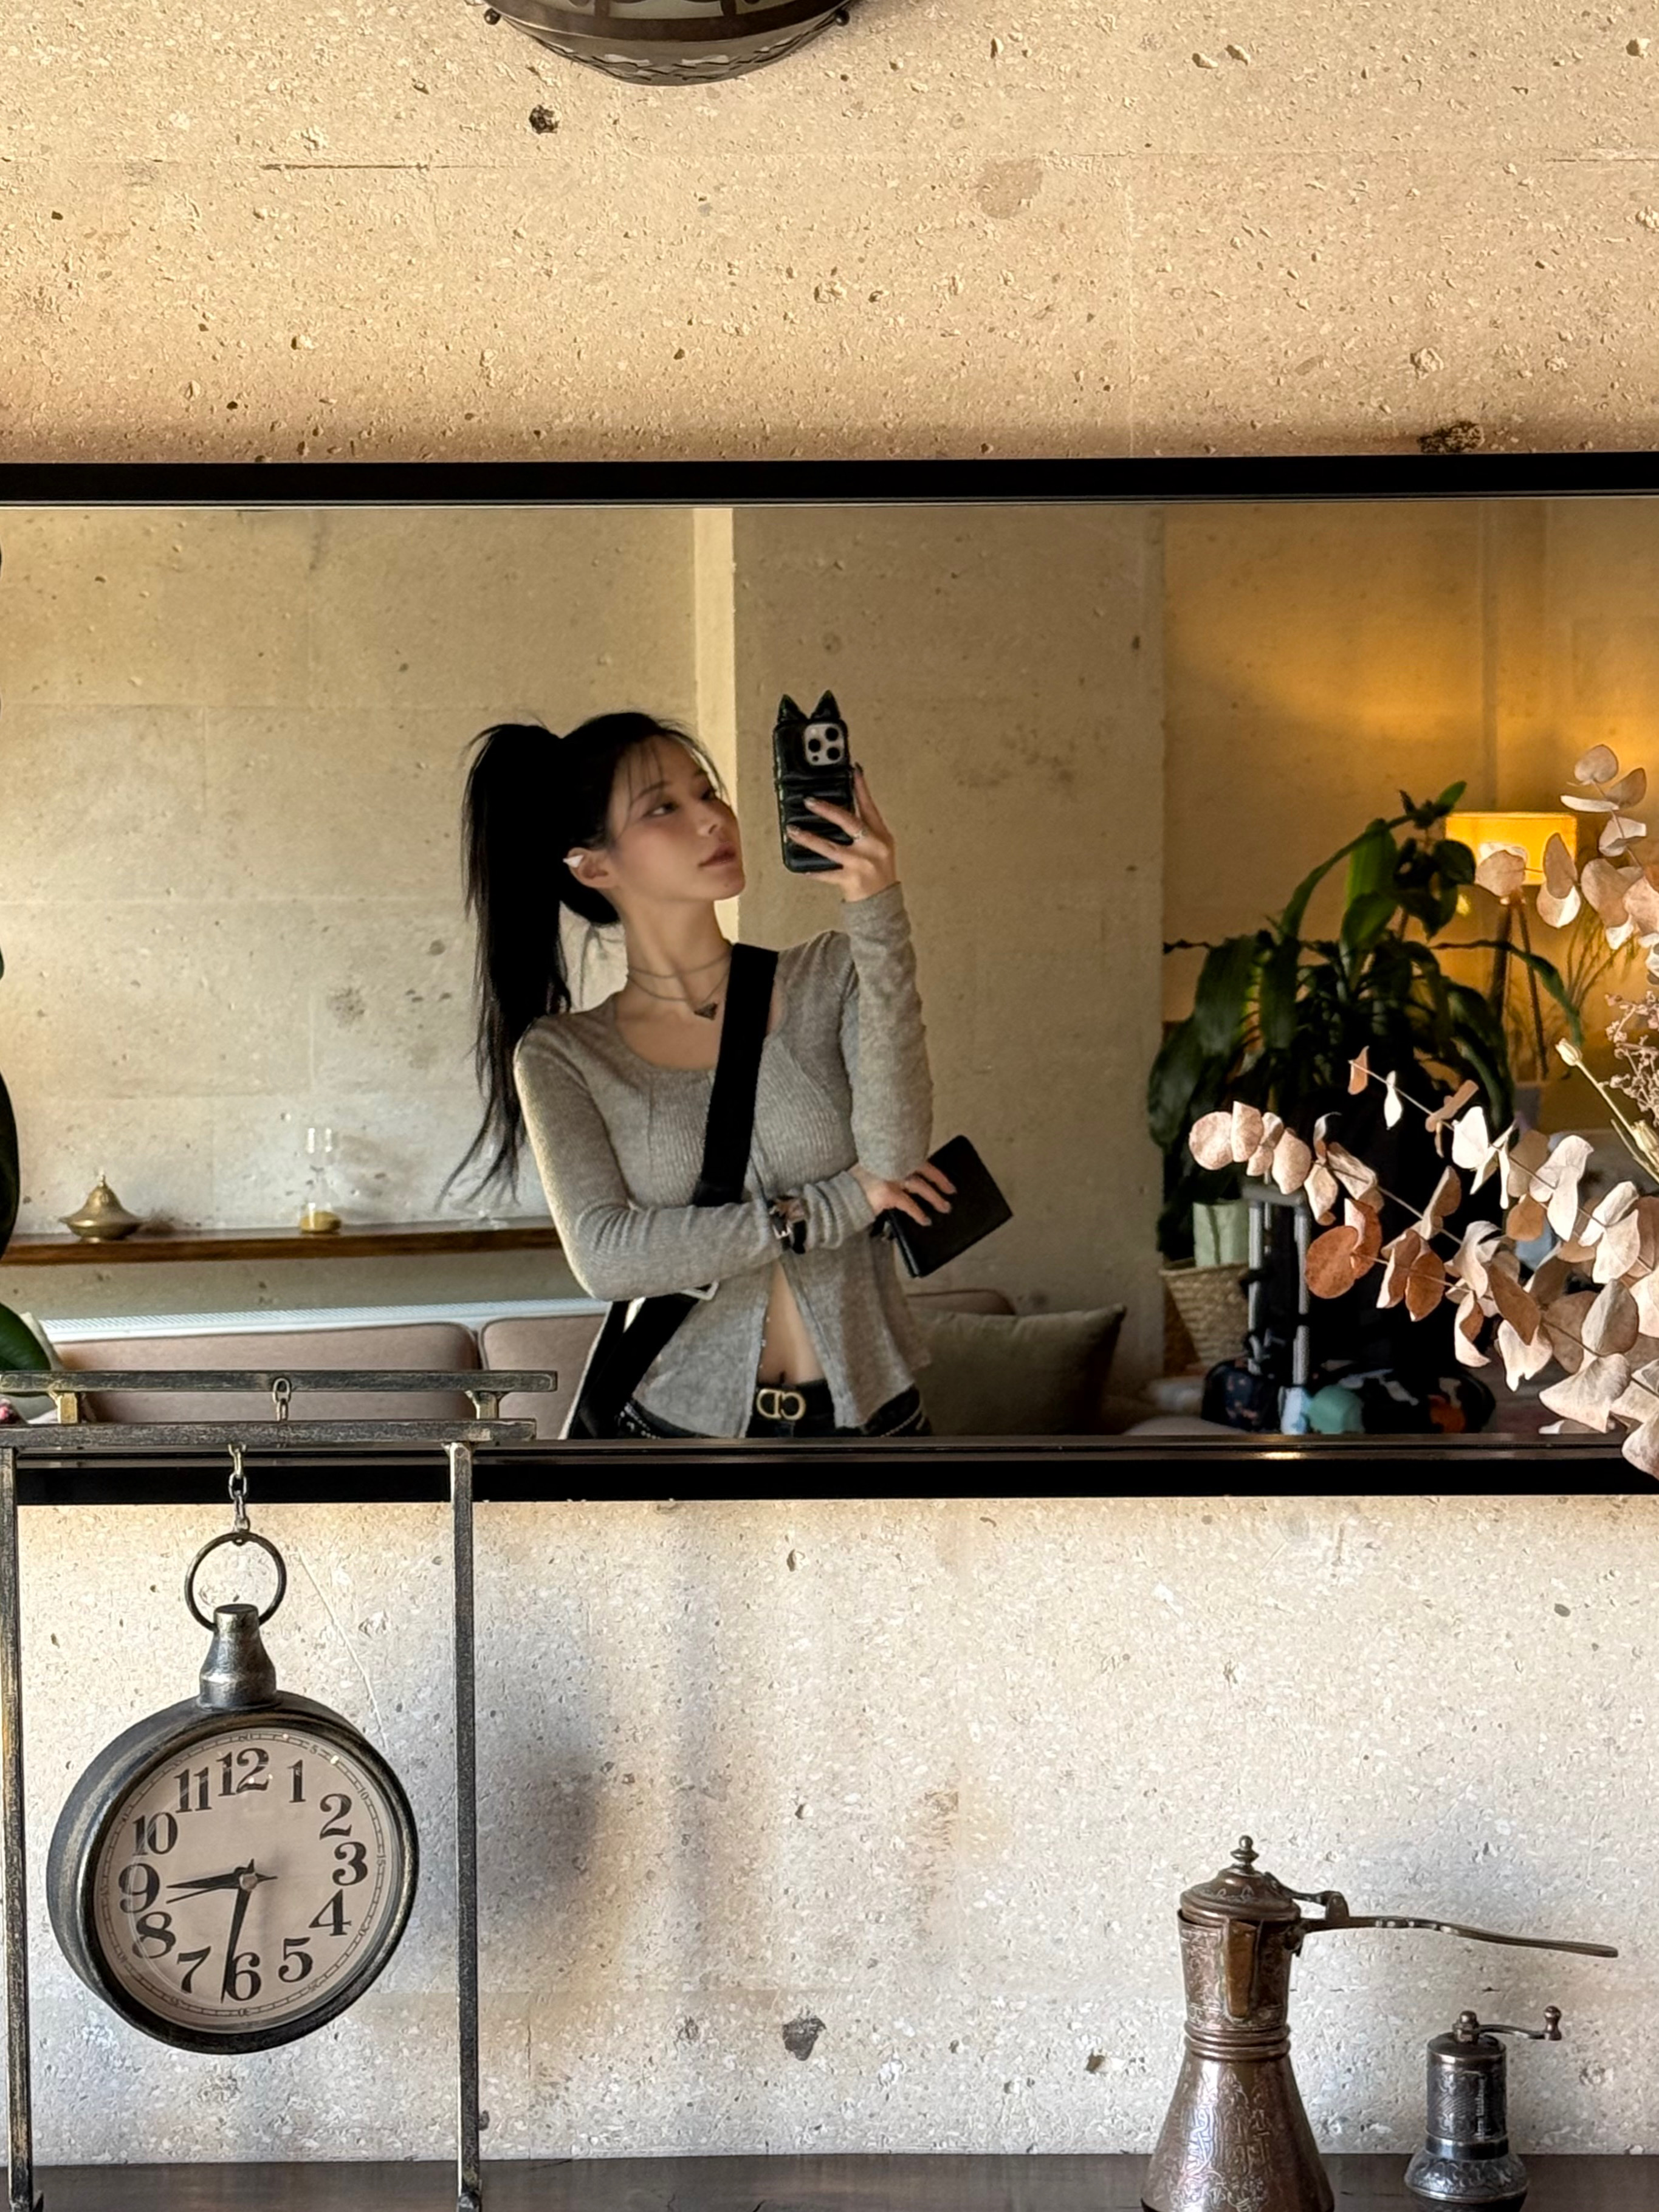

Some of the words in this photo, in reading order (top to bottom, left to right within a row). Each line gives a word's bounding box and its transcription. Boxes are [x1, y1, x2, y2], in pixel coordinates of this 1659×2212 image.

[216, 1748, 269, 1796] 12
[309, 1744, 318, 1755] 5
[174, 1767, 212, 1813] 11
[287, 1759, 306, 1803] 1
[357, 1787, 369, 1801] 10
[132, 1812, 178, 1856] 10
[319, 1793, 352, 1840] 2
[332, 1841, 368, 1886] 3
[377, 1854, 386, 1866] 15
[118, 1863, 160, 1914] 9
[132, 1911, 176, 1959] 8
[308, 1888, 352, 1937] 4
[177, 1945, 212, 1994] 7
[225, 1951, 262, 2001] 6
[278, 1937, 314, 1983] 5
